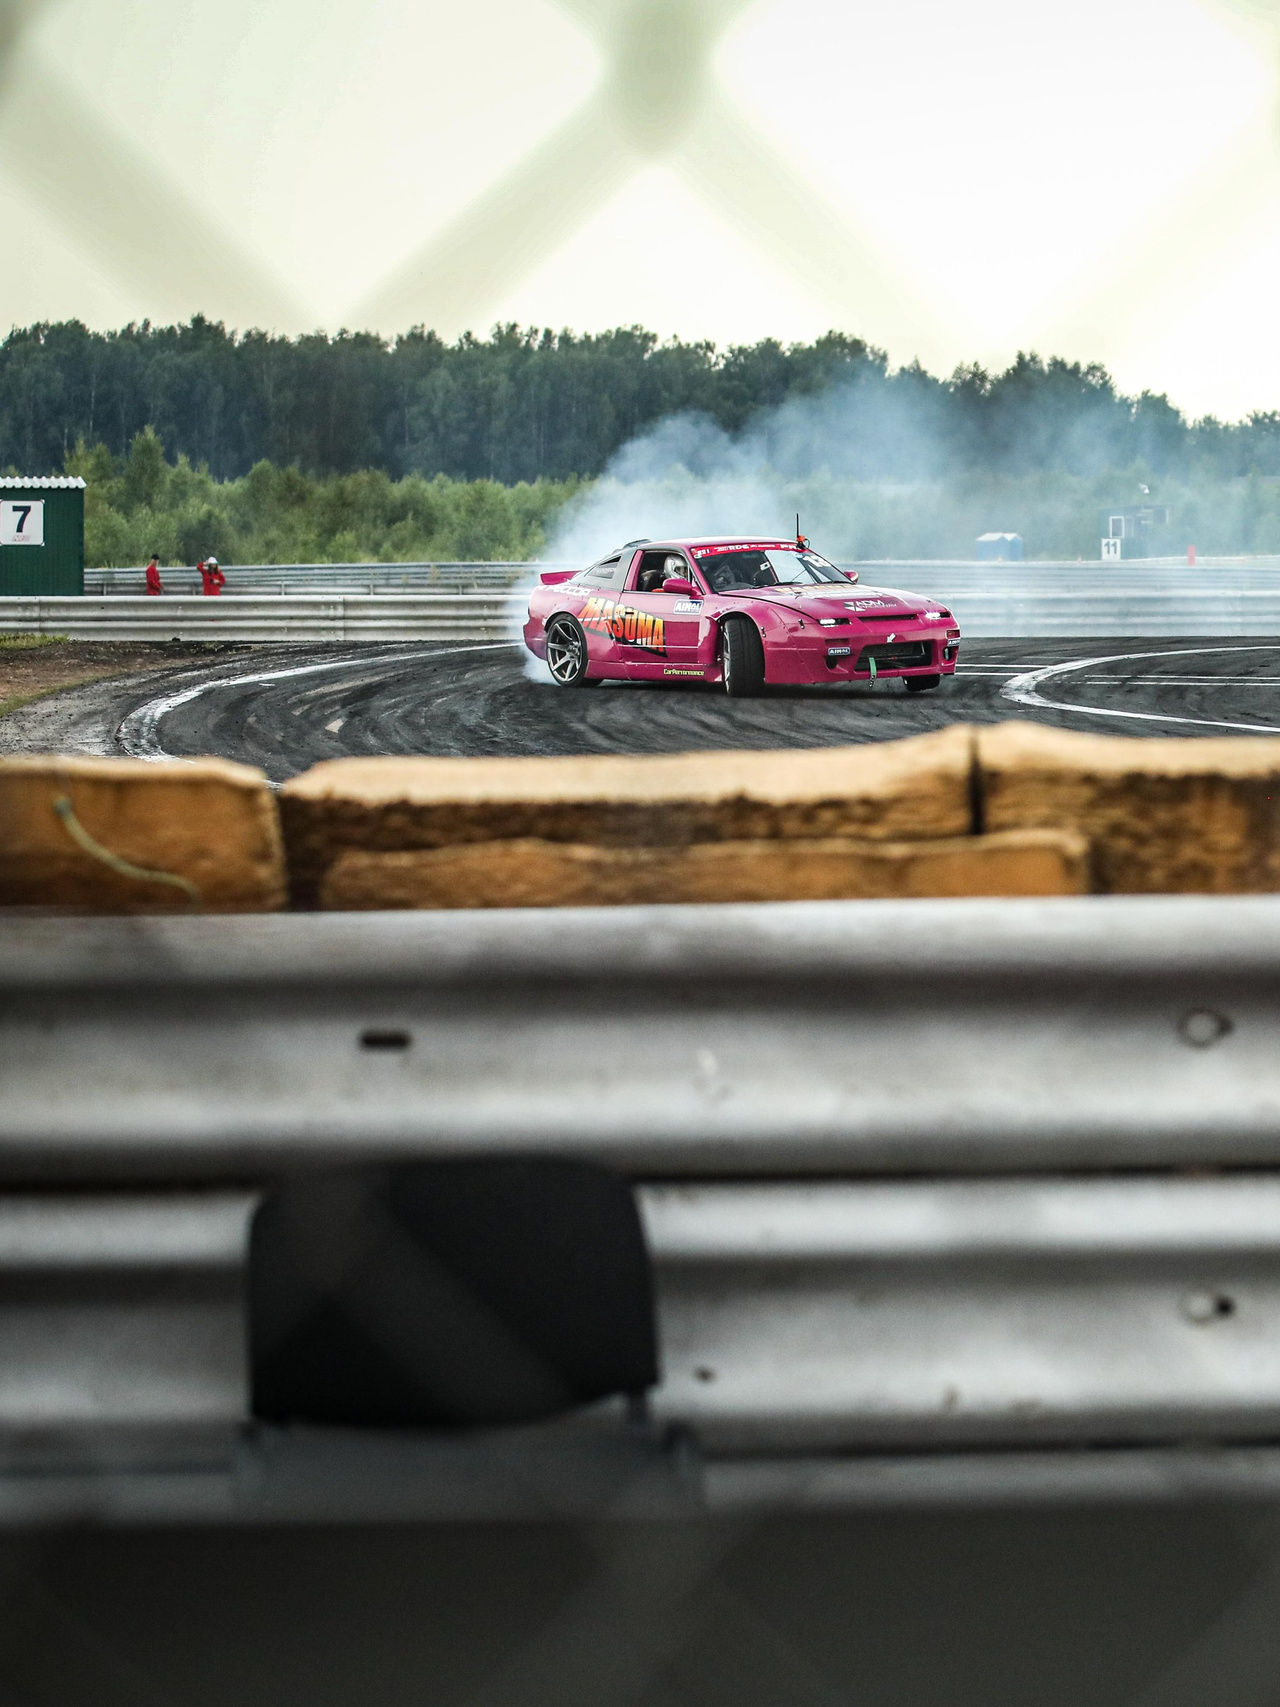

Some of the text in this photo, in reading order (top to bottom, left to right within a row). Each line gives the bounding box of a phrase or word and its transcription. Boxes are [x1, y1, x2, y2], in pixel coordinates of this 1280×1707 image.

[12, 505, 31, 533] 7
[1104, 541, 1117, 554] 11
[577, 596, 665, 653] MASUMA
